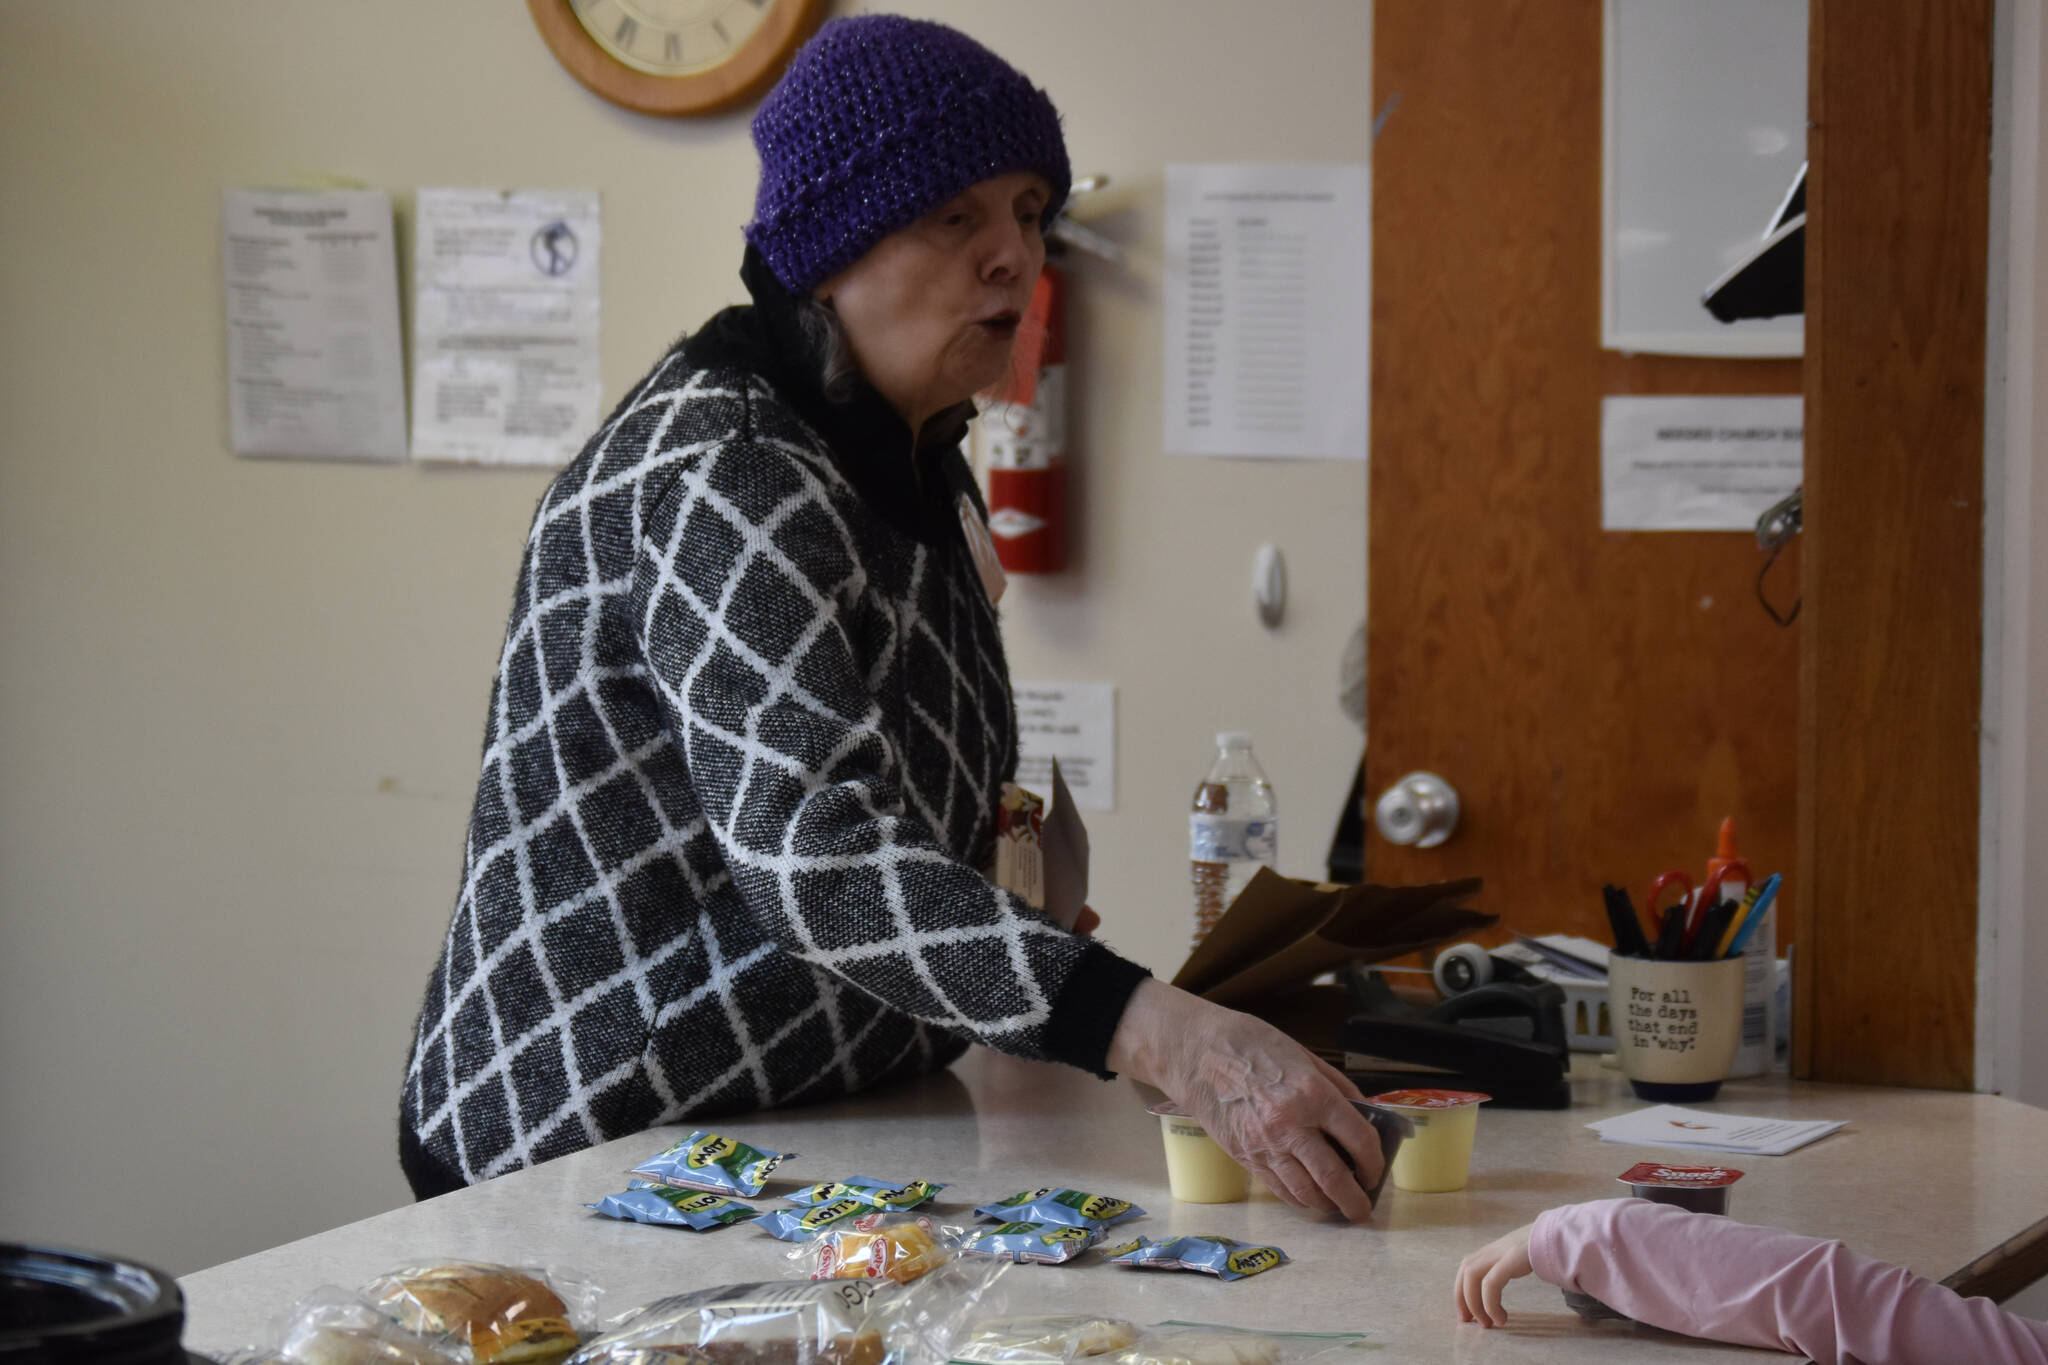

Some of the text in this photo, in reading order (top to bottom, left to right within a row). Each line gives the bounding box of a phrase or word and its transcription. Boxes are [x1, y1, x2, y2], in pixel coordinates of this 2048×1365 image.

[1631, 987, 1691, 1004] For all
[1629, 1003, 1697, 1021] the days
[1628, 1019, 1698, 1035] that end
[1634, 1034, 1649, 1048] in
